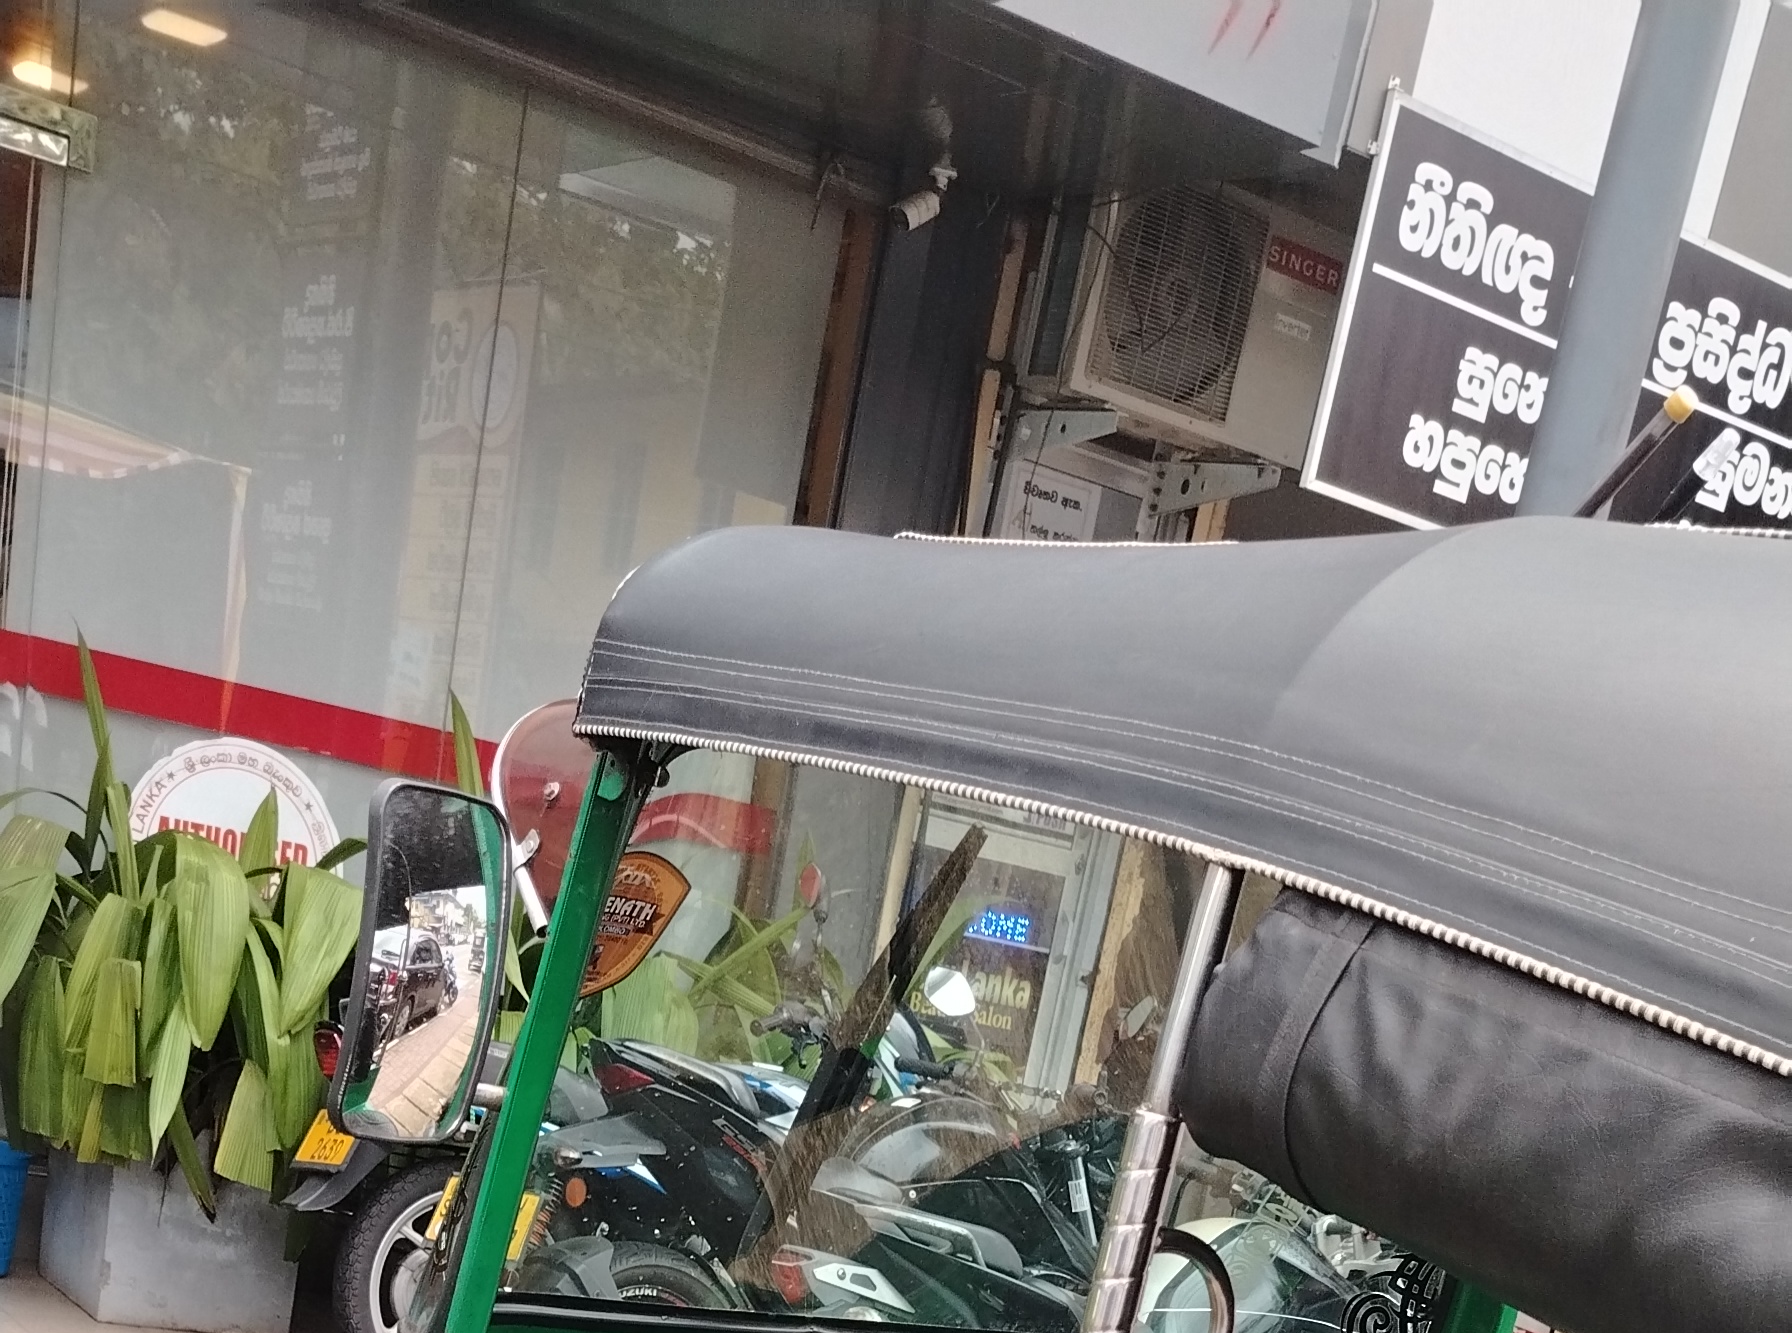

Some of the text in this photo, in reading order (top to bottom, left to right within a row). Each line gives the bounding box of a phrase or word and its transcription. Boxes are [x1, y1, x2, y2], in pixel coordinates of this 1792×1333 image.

[1398, 161, 1555, 327] නීතිඥ
[1268, 244, 1339, 288] SINGER
[236, 751, 260, 768] මහ
[131, 780, 168, 835] LANKA
[604, 896, 657, 921] ENATH
[968, 911, 1030, 942] OME
[309, 1137, 345, 1162] 2639
[618, 1287, 657, 1298] UZUKI
